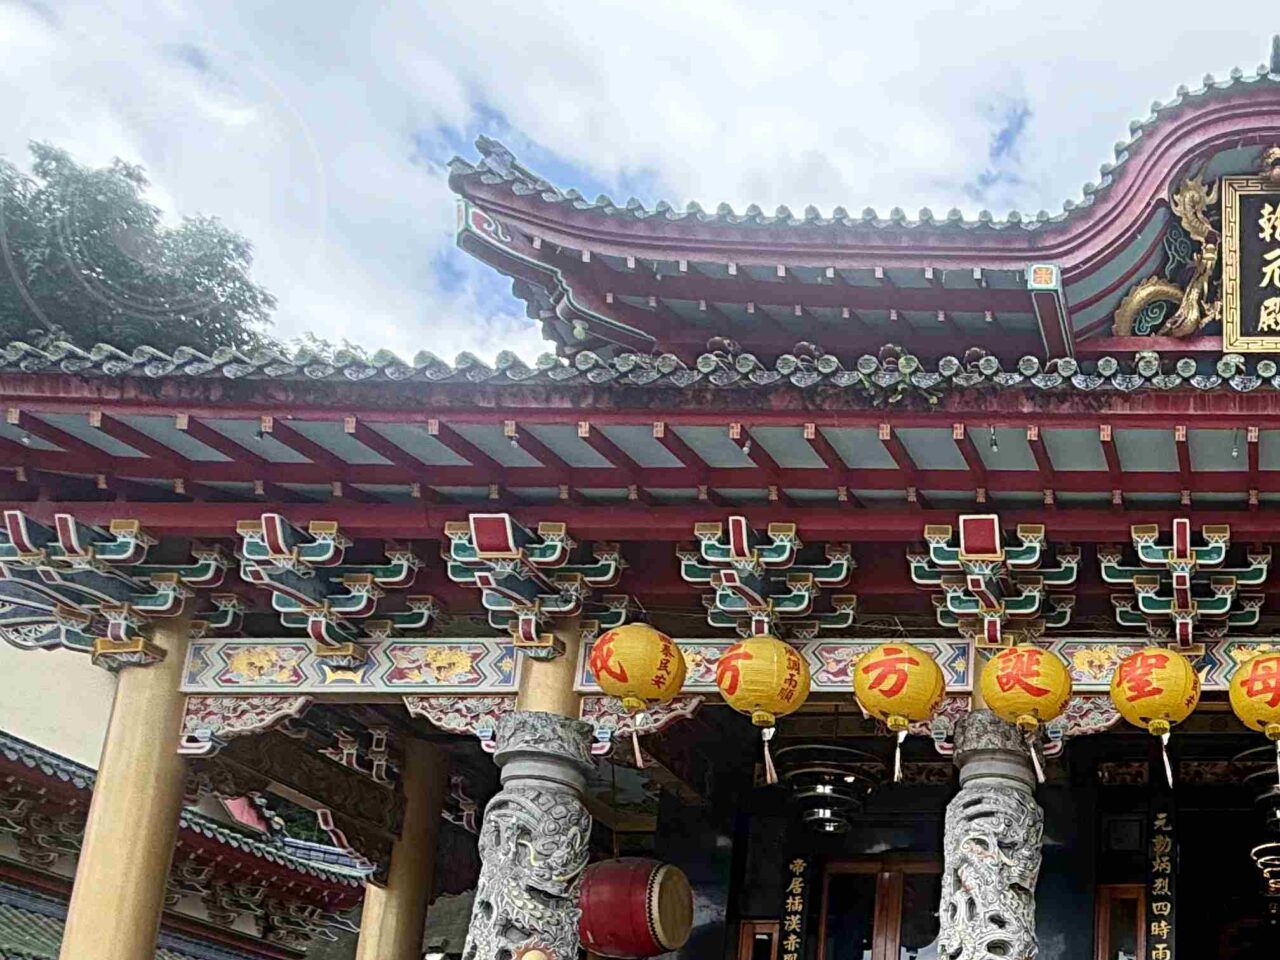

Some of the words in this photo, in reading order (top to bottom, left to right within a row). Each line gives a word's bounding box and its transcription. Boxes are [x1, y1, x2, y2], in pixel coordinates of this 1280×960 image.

[861, 647, 921, 698] 方
[996, 647, 1050, 698] 誕
[1116, 652, 1170, 703] 聖
